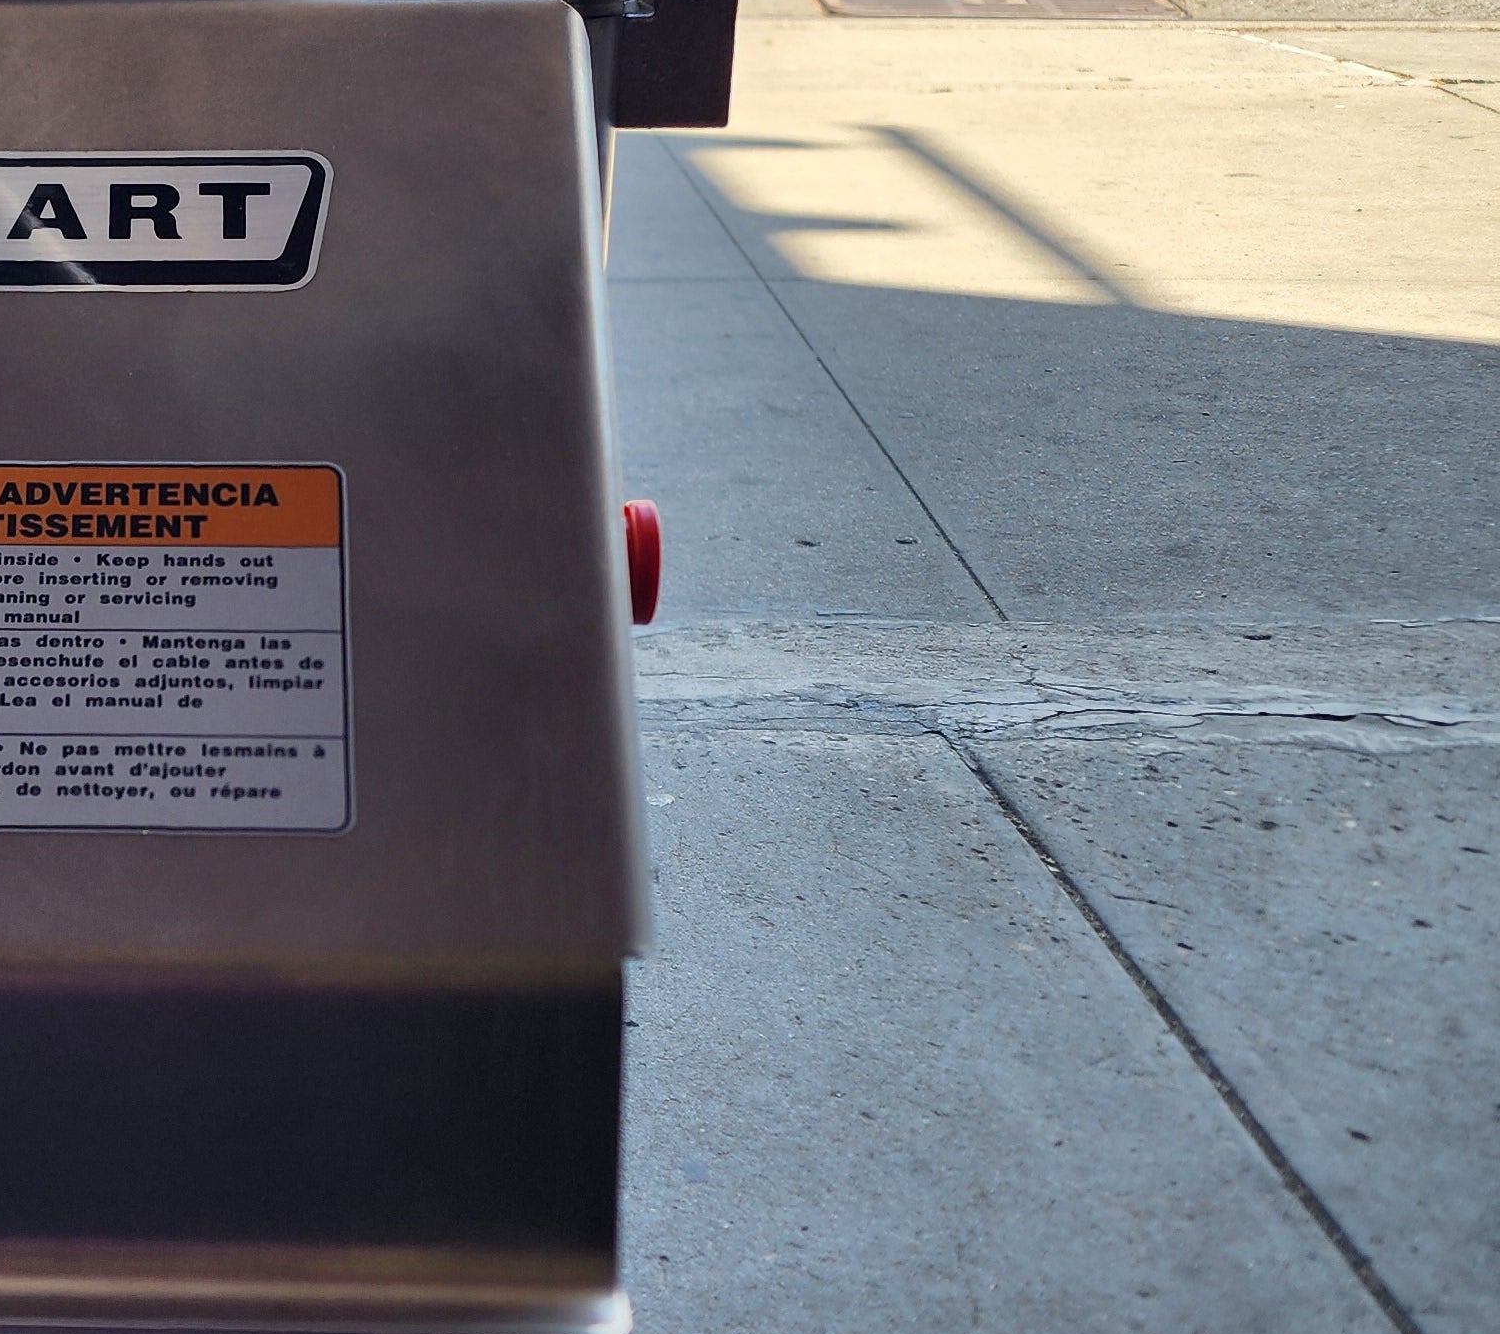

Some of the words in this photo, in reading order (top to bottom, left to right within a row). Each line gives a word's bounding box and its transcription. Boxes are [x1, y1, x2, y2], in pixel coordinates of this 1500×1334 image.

[97, 554, 149, 569] Keep
[164, 554, 225, 567] hands
[240, 555, 273, 567] out
[39, 572, 131, 588] inserting
[146, 576, 167, 585] or
[182, 573, 278, 589] removing
[65, 594, 85, 604] or
[100, 592, 196, 607] servicing
[4, 611, 79, 623] manual
[36, 635, 104, 648] dentro
[143, 636, 245, 652] Mantenga
[261, 637, 291, 650] las
[119, 655, 137, 668] el
[153, 655, 210, 668] cable
[225, 656, 284, 669] antes
[299, 657, 324, 670] de
[4, 674, 120, 687] accesorios
[135, 674, 233, 691] adjuntos,
[249, 675, 324, 691] limpiar
[0, 693, 36, 706] Lea
[52, 694, 70, 707] el
[86, 694, 162, 707] manual
[178, 695, 202, 708] de
[20, 742, 47, 755] Ne
[63, 745, 99, 758] pas
[115, 743, 186, 756] mettre
[202, 743, 298, 758] lesmains
[313, 745, 325, 758] à
[55, 763, 113, 776] avant
[16, 783, 41, 796] de
[57, 783, 154, 799] nettoyer,
[170, 787, 196, 797] ou
[211, 783, 281, 801] répare
